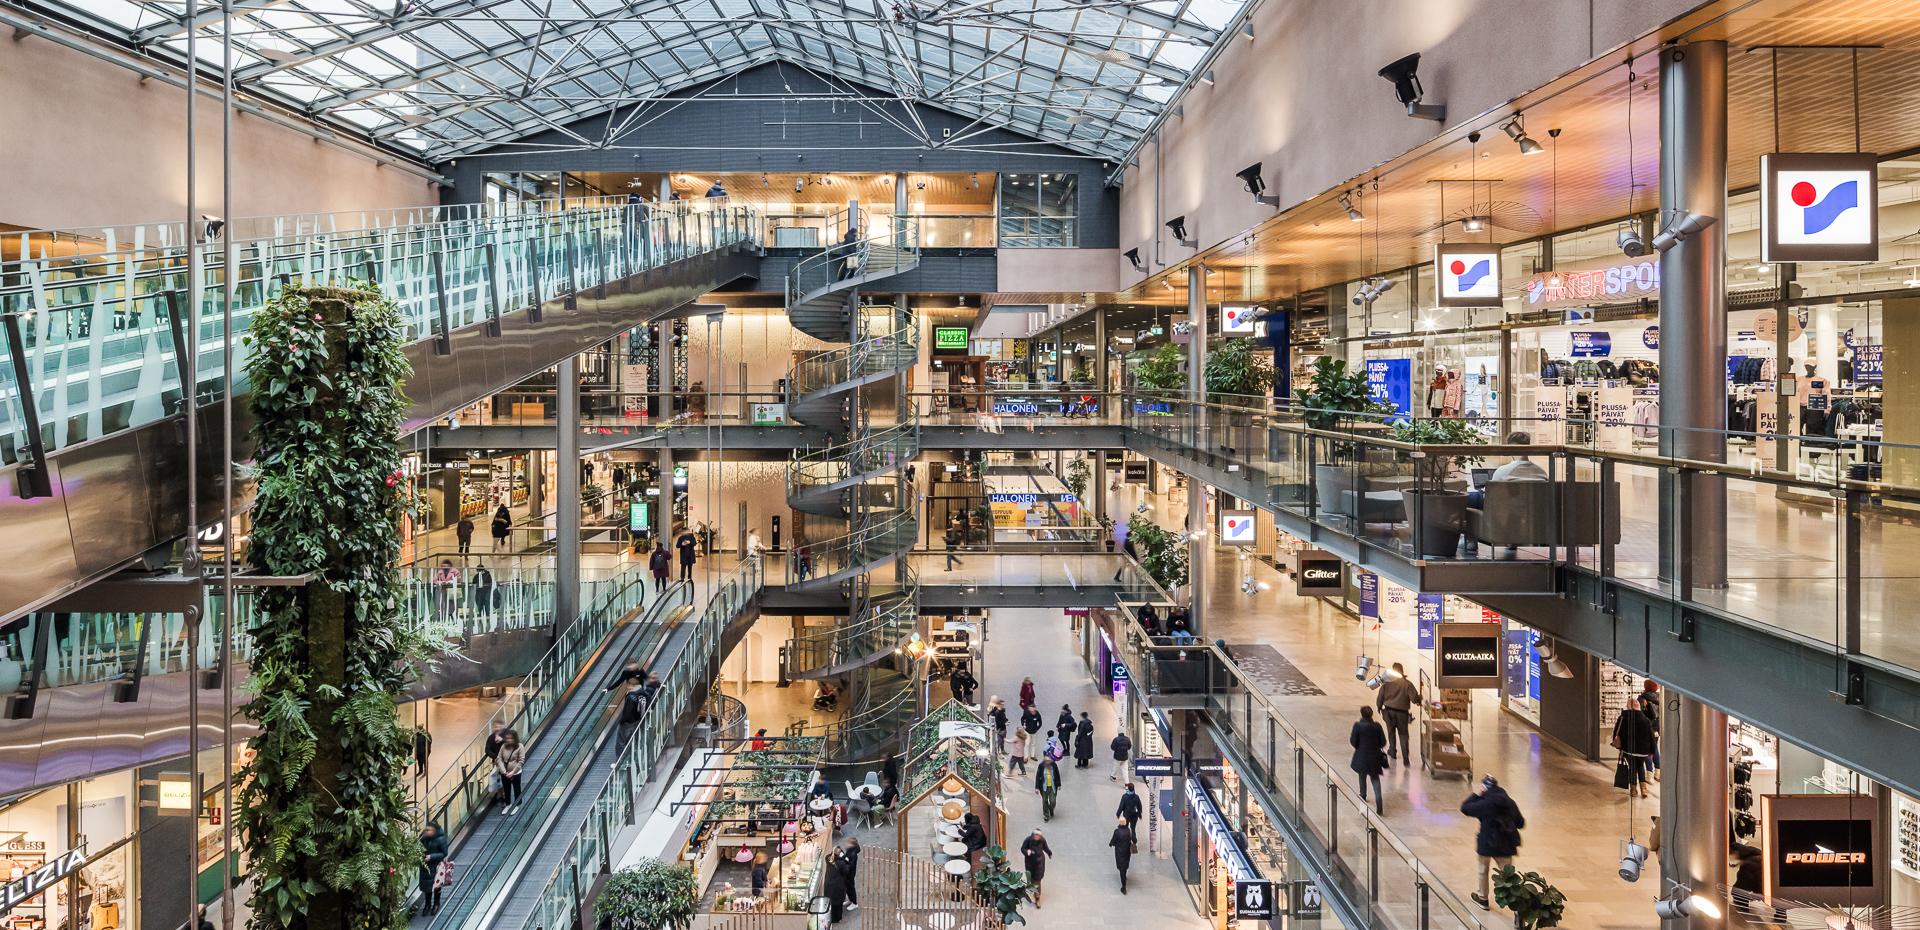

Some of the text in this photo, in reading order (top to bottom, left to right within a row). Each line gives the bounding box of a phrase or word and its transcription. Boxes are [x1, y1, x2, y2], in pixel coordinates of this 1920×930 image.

[993, 404, 1038, 413] HALONEN
[993, 494, 1037, 502] HALONEN
[1304, 569, 1339, 579] Glitter
[1420, 613, 1439, 621] -20%
[1452, 653, 1494, 661] KULTA-AIKA
[1786, 852, 1866, 864] POWER
